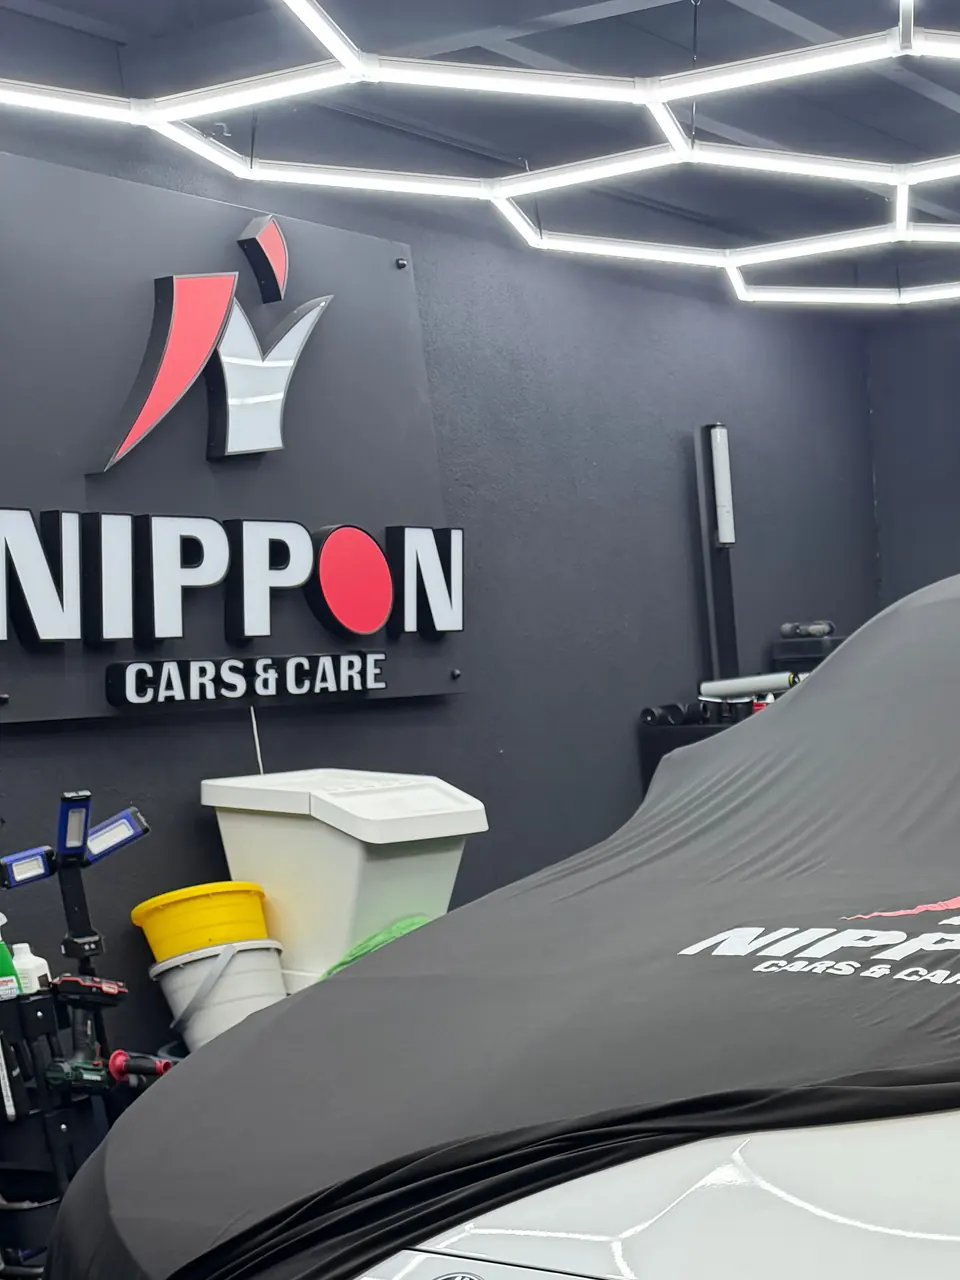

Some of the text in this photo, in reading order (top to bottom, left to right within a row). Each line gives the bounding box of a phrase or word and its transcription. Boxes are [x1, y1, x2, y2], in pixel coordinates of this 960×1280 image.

[0, 507, 464, 642] NIPPON
[752, 959, 862, 977] CARS
[860, 964, 892, 980] &
